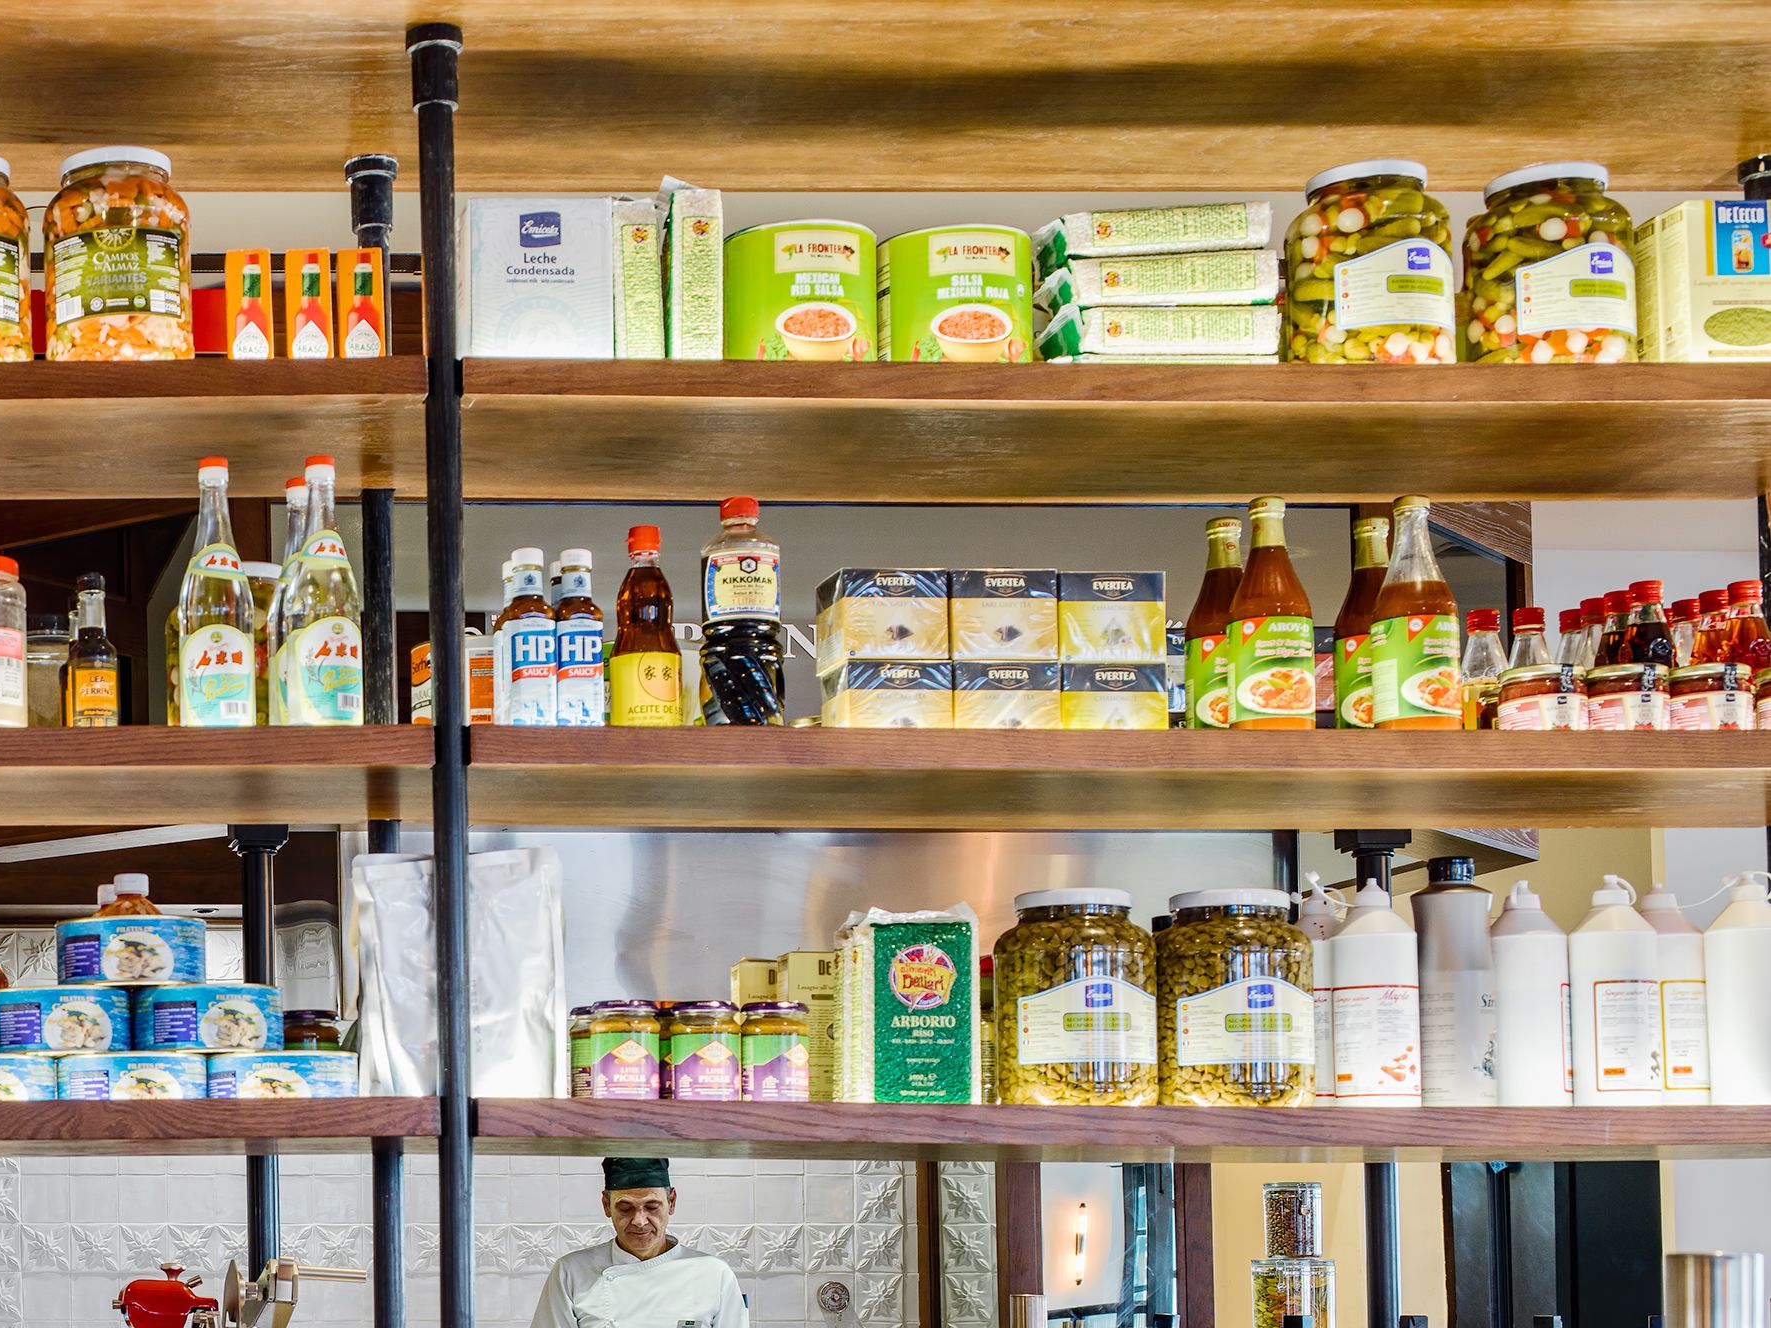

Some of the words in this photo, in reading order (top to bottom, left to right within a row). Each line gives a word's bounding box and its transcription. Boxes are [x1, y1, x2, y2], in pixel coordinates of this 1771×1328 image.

[794, 243, 804, 254] LA
[949, 245, 959, 256] LA
[92, 252, 141, 265] CAMPOS
[524, 252, 557, 264] Leche
[102, 262, 140, 273] ALMAZ
[506, 266, 575, 275] Condensada
[86, 273, 147, 287] VARIANTES
[795, 272, 841, 285] MEXICAN
[951, 275, 983, 287] SALSA
[790, 285, 811, 297] RED
[814, 285, 845, 297] SALSA
[937, 287, 983, 300] MEXICANA
[722, 576, 773, 585] KIKKOMAN
[876, 577, 916, 588] EVERTEA
[985, 577, 1026, 588] EVERTEA
[1092, 581, 1134, 592] EVERTEA
[515, 635, 555, 662] HP
[561, 635, 602, 662] HP
[522, 666, 549, 676] SAUCE
[568, 666, 595, 677] SAUCE
[880, 669, 921, 680] EVERTEA
[988, 669, 1029, 680] EVERTEA
[1095, 670, 1136, 682] EVERTEA
[628, 704, 660, 714] ACEITE
[663, 705, 673, 713] DE
[890, 1015, 957, 1028] ARBORIO
[912, 1029, 934, 1037] RISO
[613, 1074, 646, 1083] PICKLE
[698, 1075, 731, 1083] PICKLE
